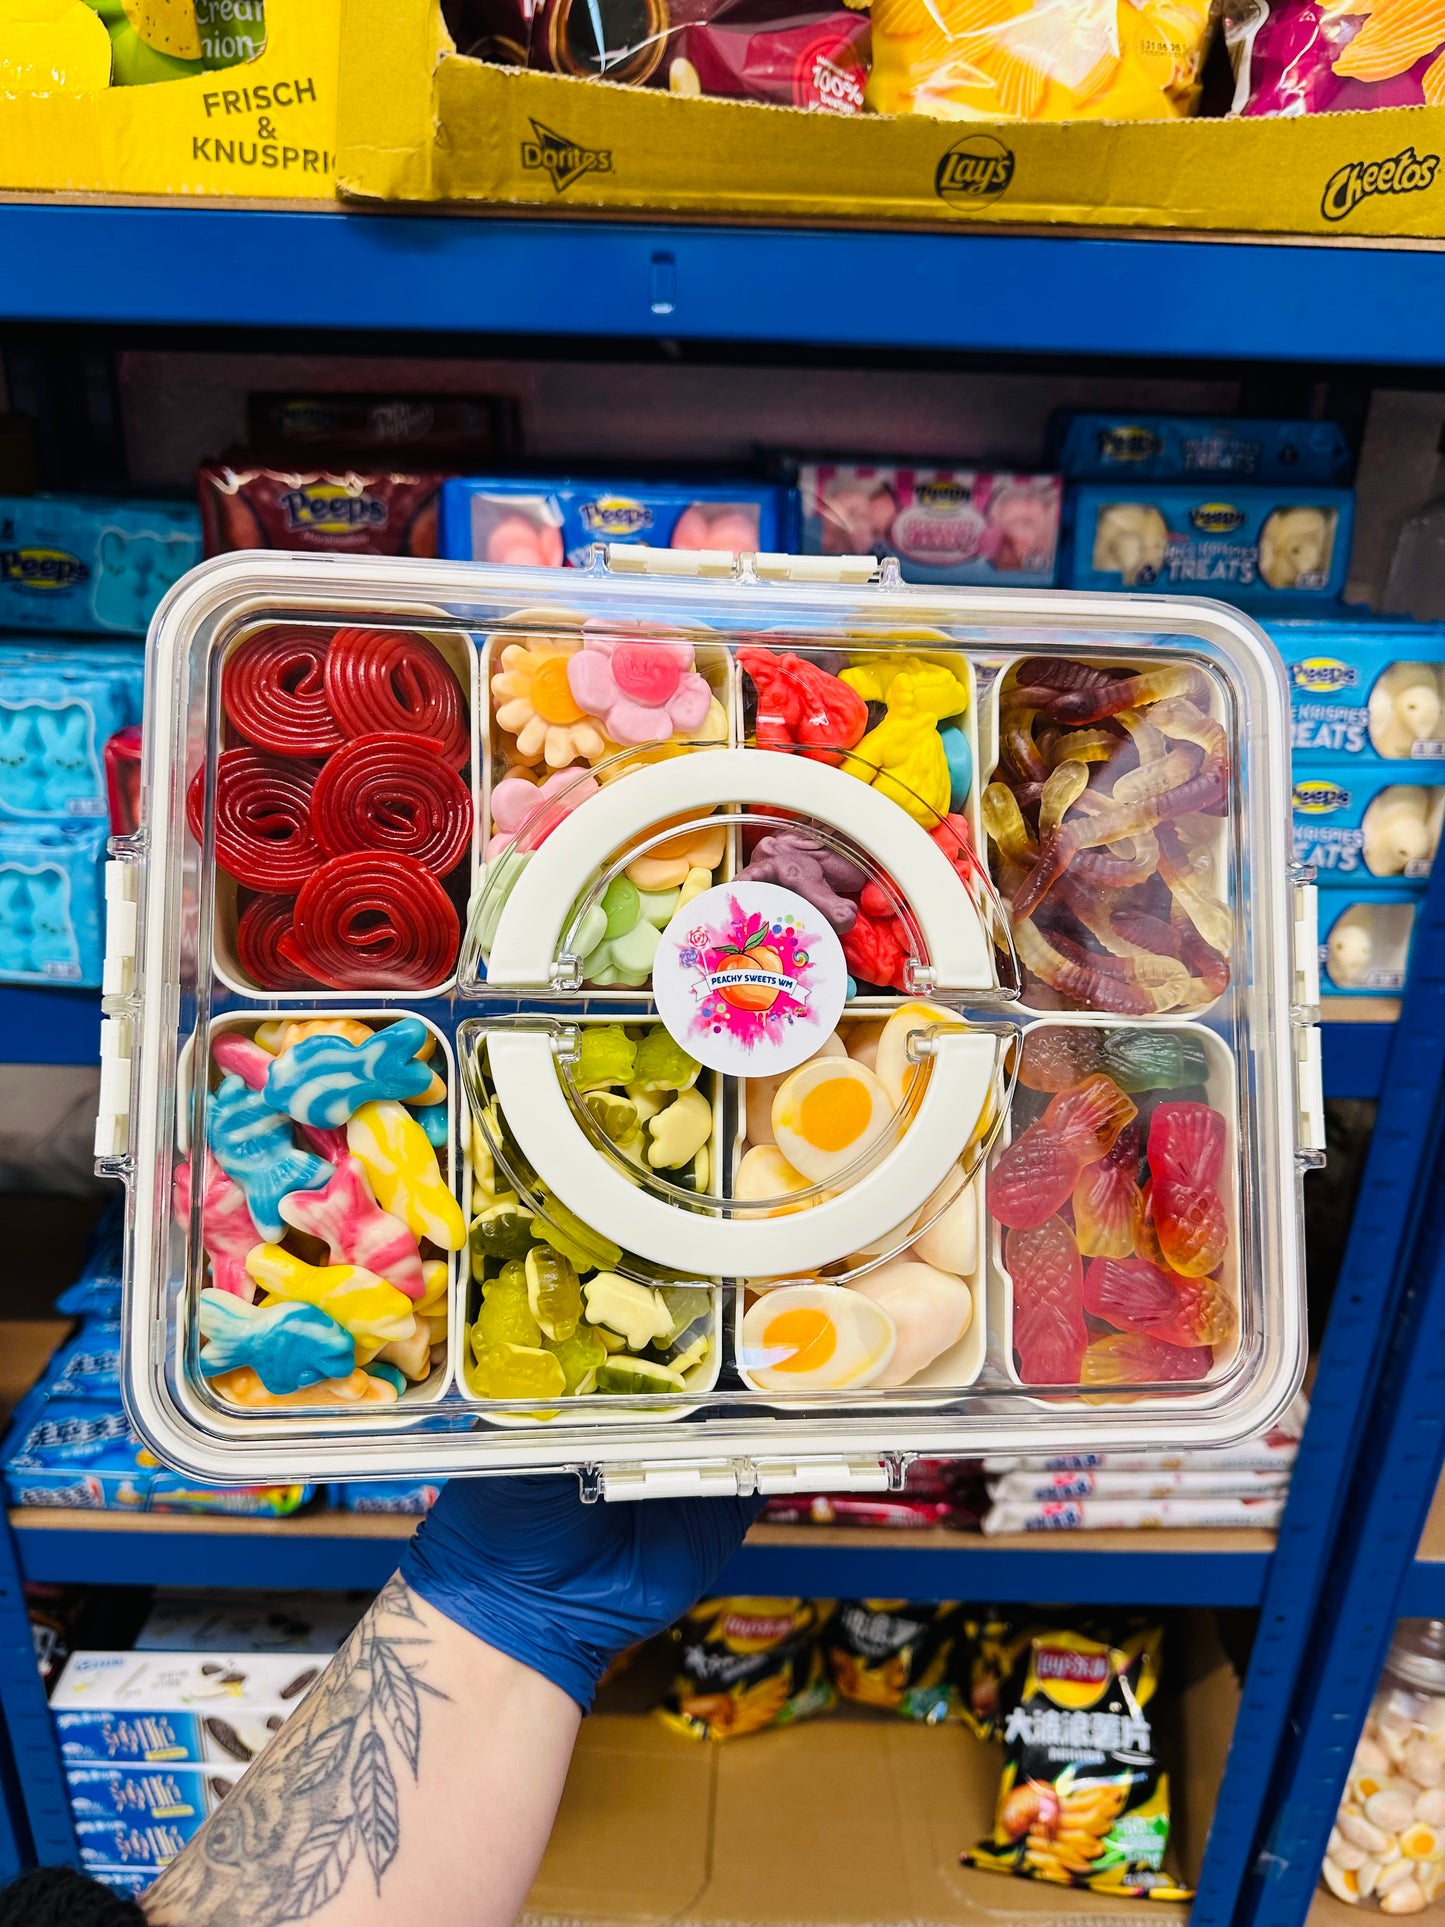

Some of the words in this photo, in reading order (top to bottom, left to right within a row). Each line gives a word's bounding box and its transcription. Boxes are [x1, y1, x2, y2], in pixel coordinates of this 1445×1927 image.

[201, 30, 256, 59] nion
[203, 78, 317, 118] FRISCH
[812, 65, 864, 106] 100%
[257, 116, 278, 141] &
[192, 136, 337, 174] KNUSPRI
[521, 142, 613, 173] Doritos
[1321, 146, 1440, 222] Cheetos
[280, 492, 388, 532] Peeps
[578, 501, 655, 531] Peeps
[1168, 559, 1255, 584] TREATS
[1288, 663, 1358, 690] Peeps
[1291, 722, 1366, 753] EATS
[1293, 841, 1359, 872] EATS
[711, 974, 743, 985] PEACHY
[744, 974, 777, 985] SWEETS
[778, 978, 793, 989] WM
